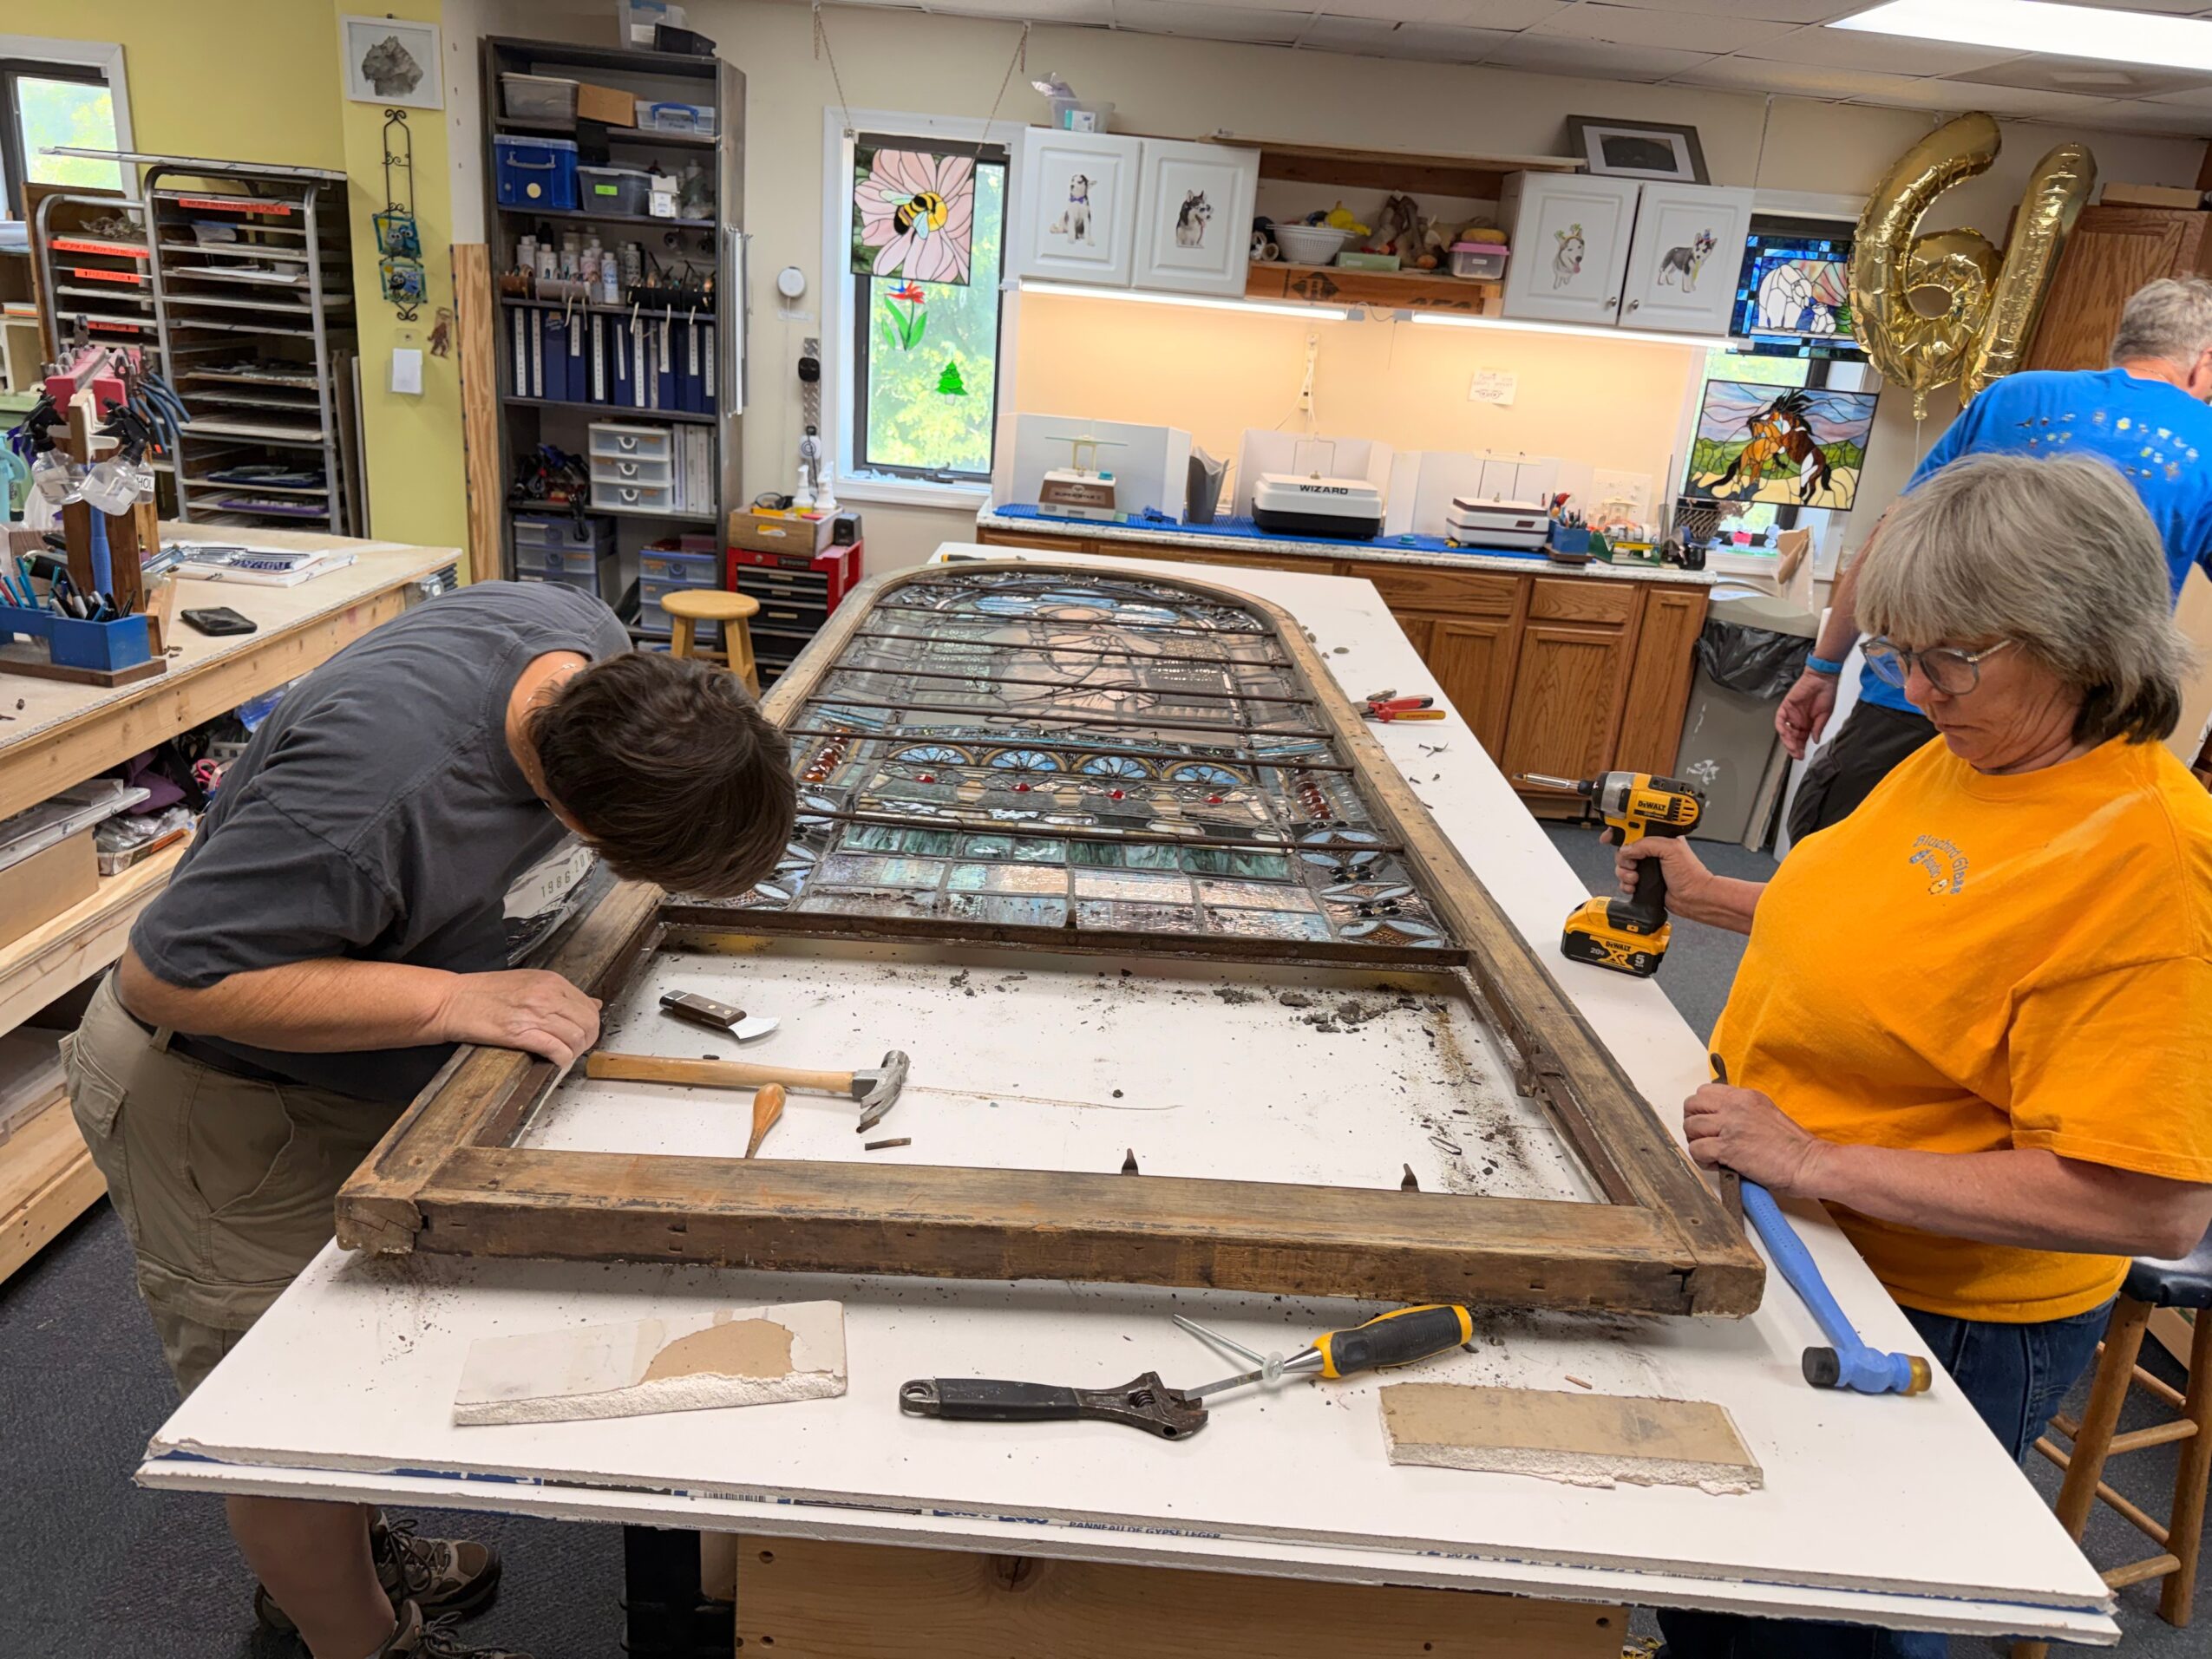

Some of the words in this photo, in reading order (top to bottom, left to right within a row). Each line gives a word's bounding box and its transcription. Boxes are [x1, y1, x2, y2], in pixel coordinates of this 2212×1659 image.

[137, 477, 152, 490] HOL
[1299, 484, 1349, 495] WIZARD
[1913, 834, 1963, 859] Bluebird
[1950, 857, 1968, 894] Glass
[1069, 1521, 1125, 1532] PANNEAU
